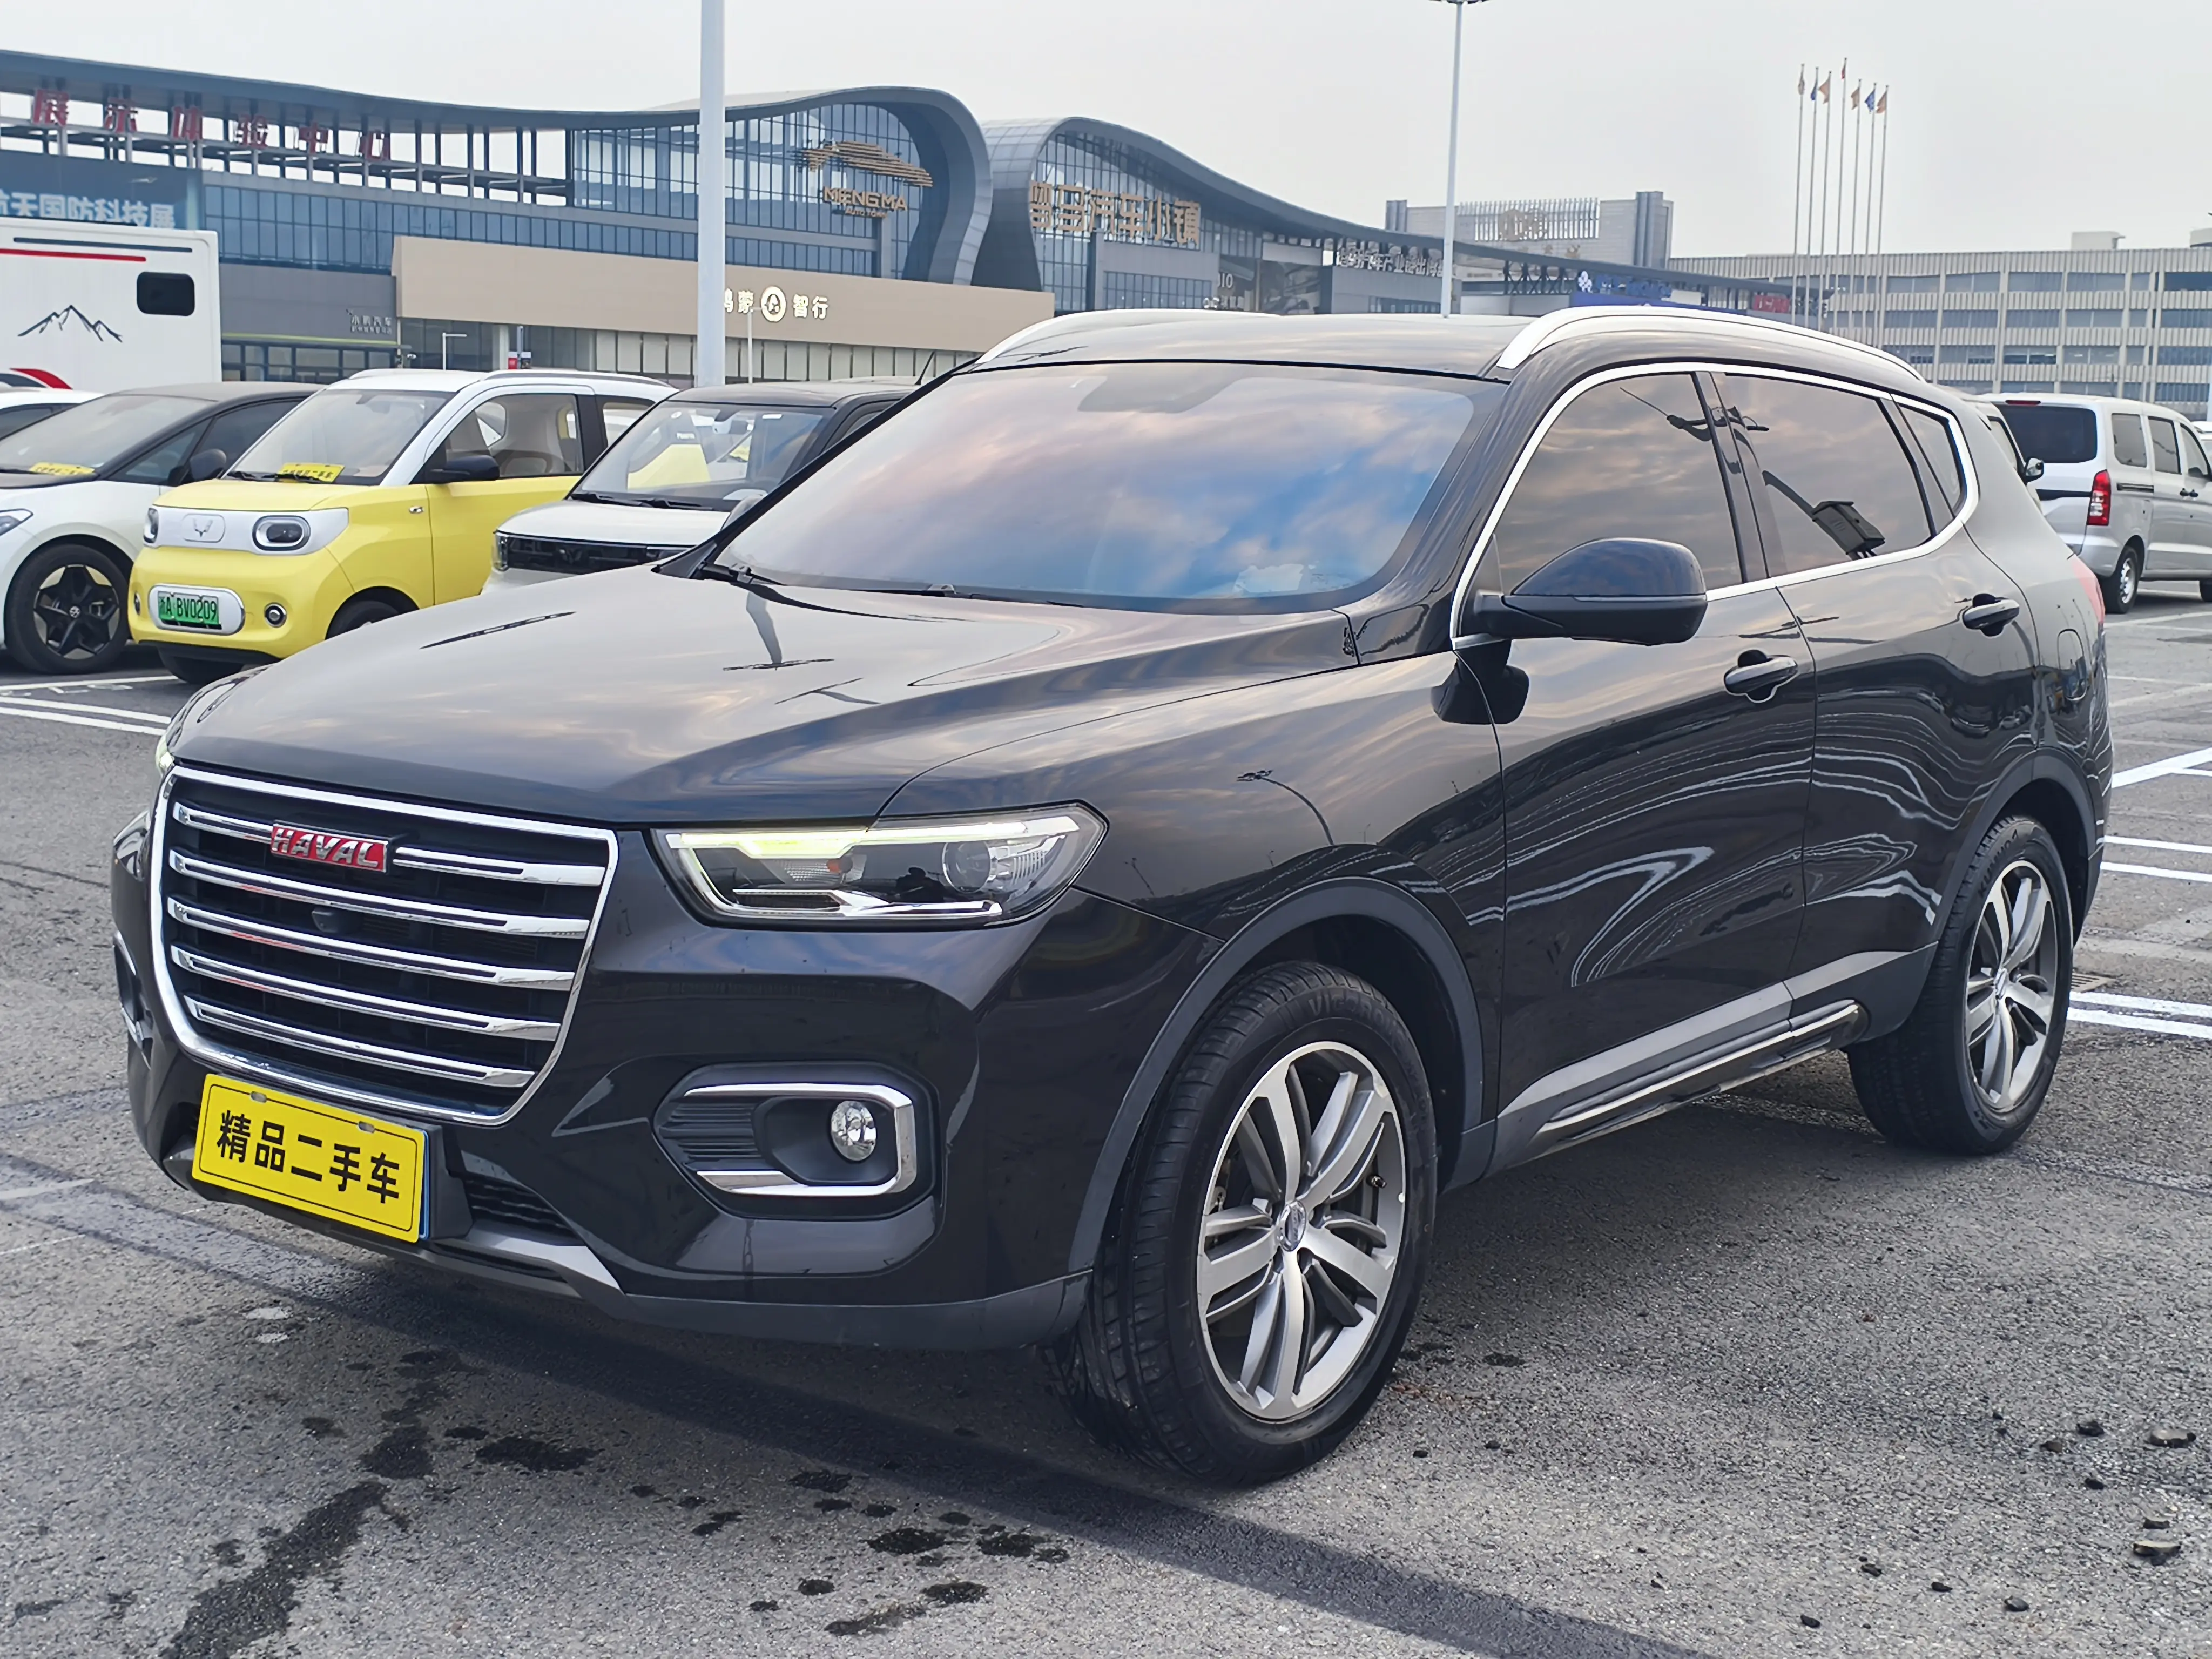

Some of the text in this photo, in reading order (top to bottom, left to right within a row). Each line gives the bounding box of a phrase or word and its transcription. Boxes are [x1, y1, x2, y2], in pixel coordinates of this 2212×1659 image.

[31, 89, 392, 162] 展示体验中心
[823, 186, 908, 211] MENGMA
[845, 207, 864, 216] AUTO
[793, 294, 828, 319] 智行
[272, 828, 378, 867] HAVAL
[217, 1110, 400, 1204] 精品二手车
